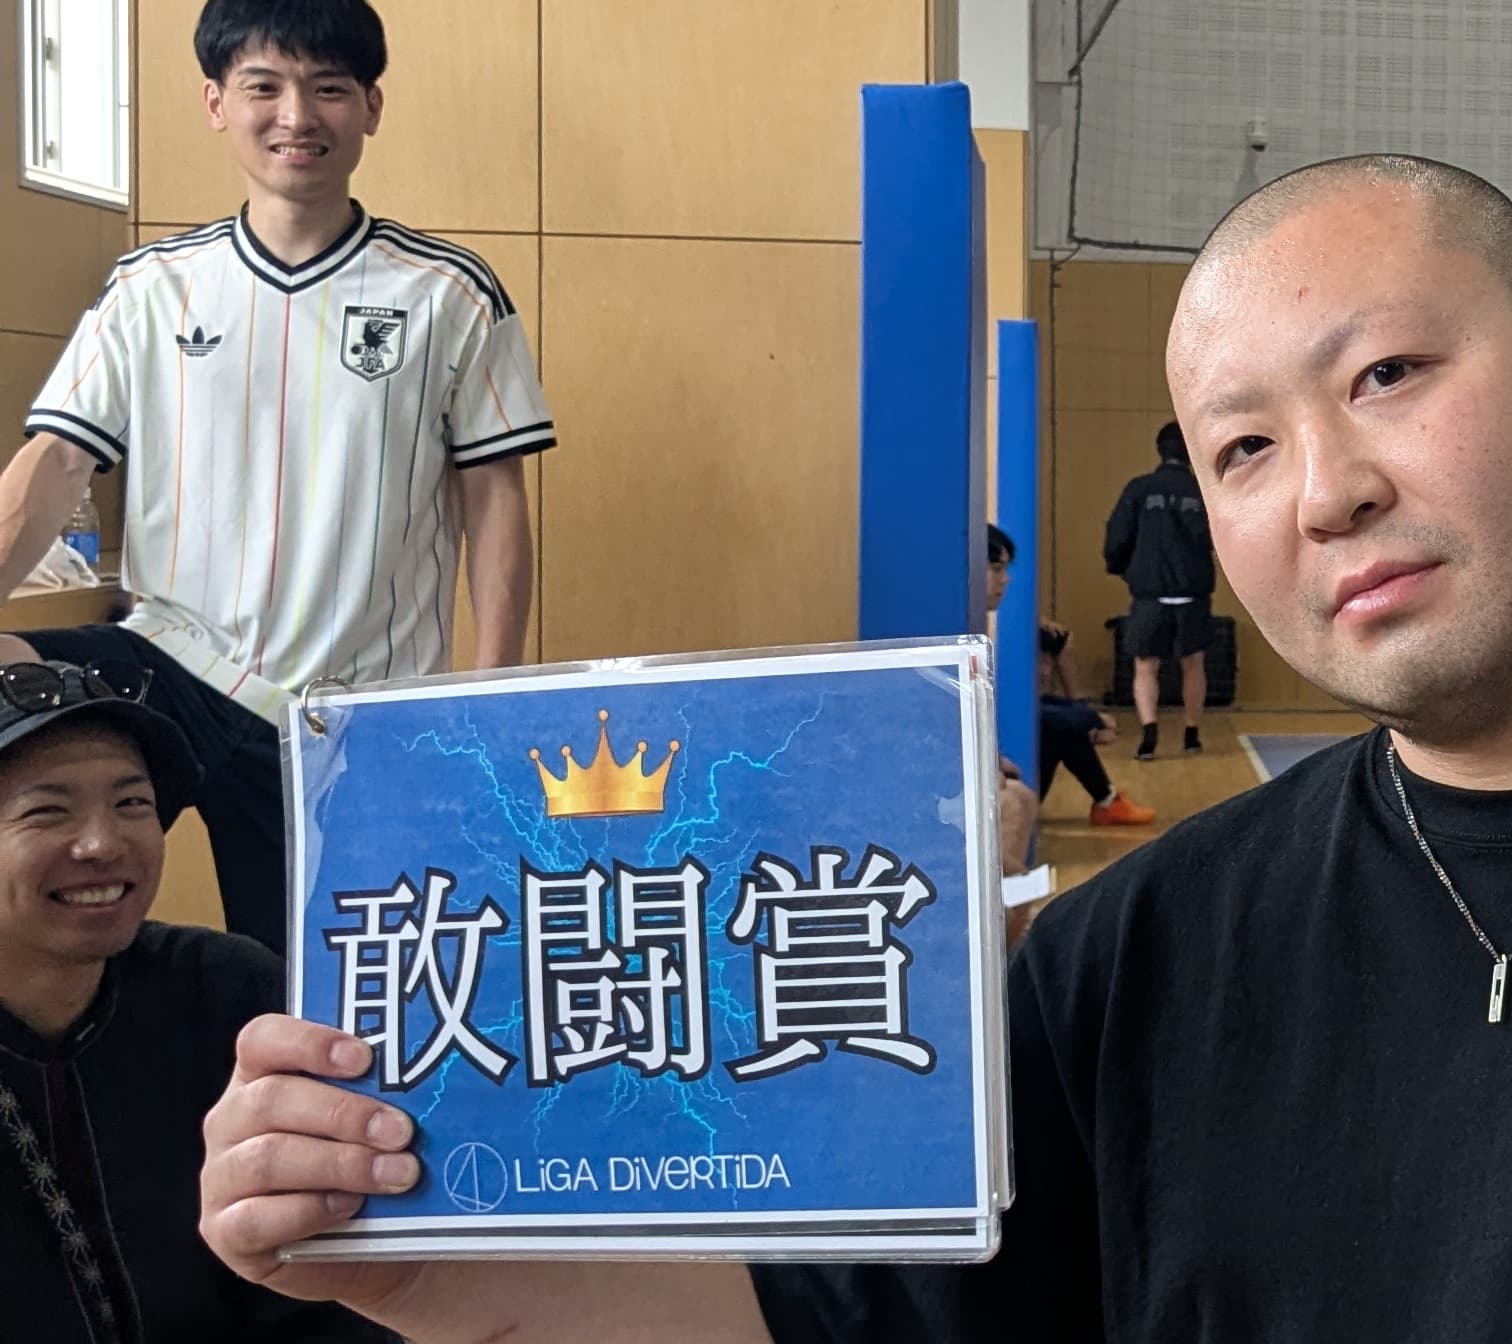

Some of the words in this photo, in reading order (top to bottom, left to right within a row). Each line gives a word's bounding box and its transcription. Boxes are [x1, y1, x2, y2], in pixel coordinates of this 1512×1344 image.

[359, 307, 395, 317] JAPAN
[323, 843, 938, 1090] 敢闘賞
